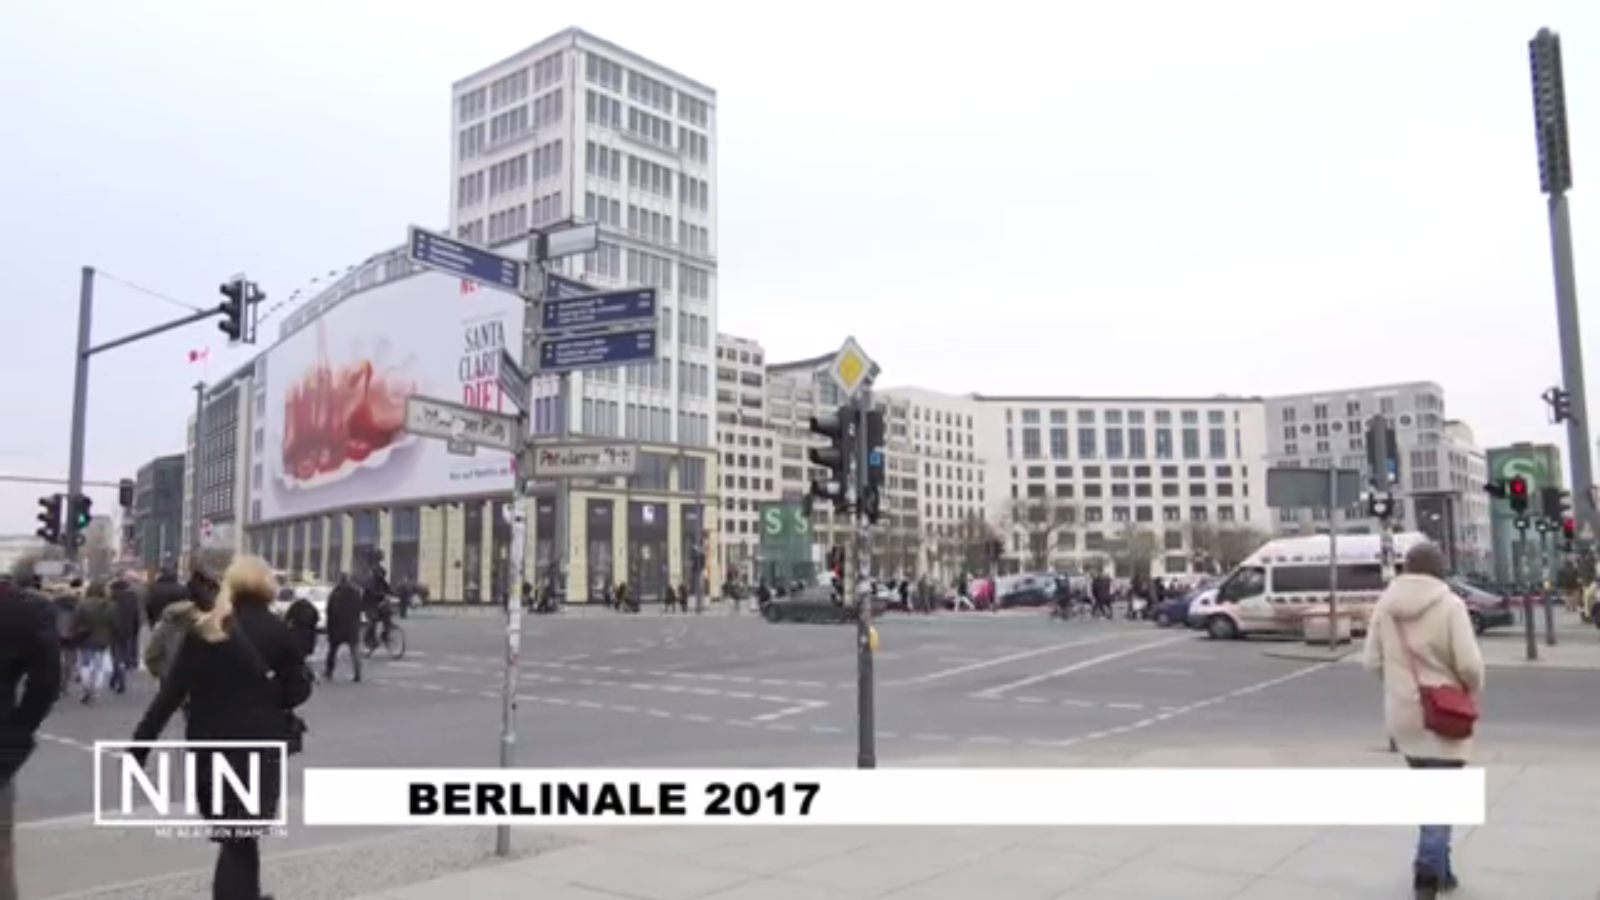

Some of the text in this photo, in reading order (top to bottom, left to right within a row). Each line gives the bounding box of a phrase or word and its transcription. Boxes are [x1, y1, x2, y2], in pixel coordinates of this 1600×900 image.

[464, 320, 505, 354] SANTA
[459, 350, 499, 382] CLARI
[765, 508, 782, 534] S
